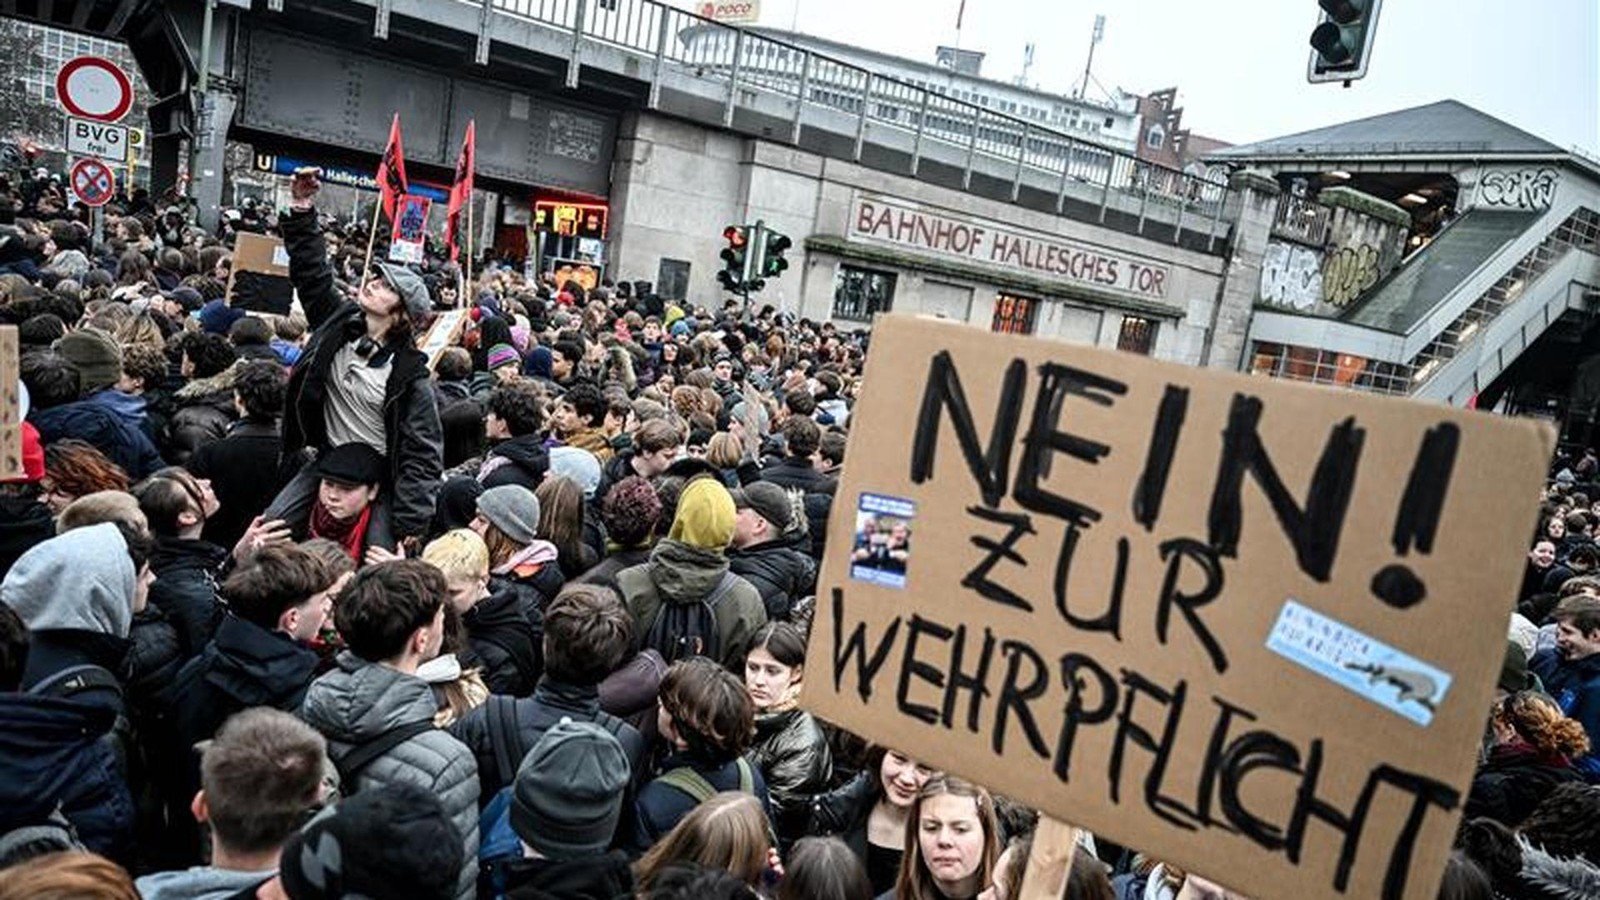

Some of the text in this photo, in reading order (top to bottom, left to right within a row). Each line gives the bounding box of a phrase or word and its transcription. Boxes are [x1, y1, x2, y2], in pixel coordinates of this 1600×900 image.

[716, 4, 752, 18] POCO
[76, 122, 119, 144] BVG
[87, 142, 106, 153] frei
[257, 155, 271, 170] U
[326, 169, 378, 188] Hallesche
[857, 203, 1165, 293] BAHNHOF HALLESCHES TOR
[909, 350, 1461, 610] NEIN!
[961, 504, 1228, 674] ZUR
[831, 588, 1462, 900] WEHRPFLICHT
